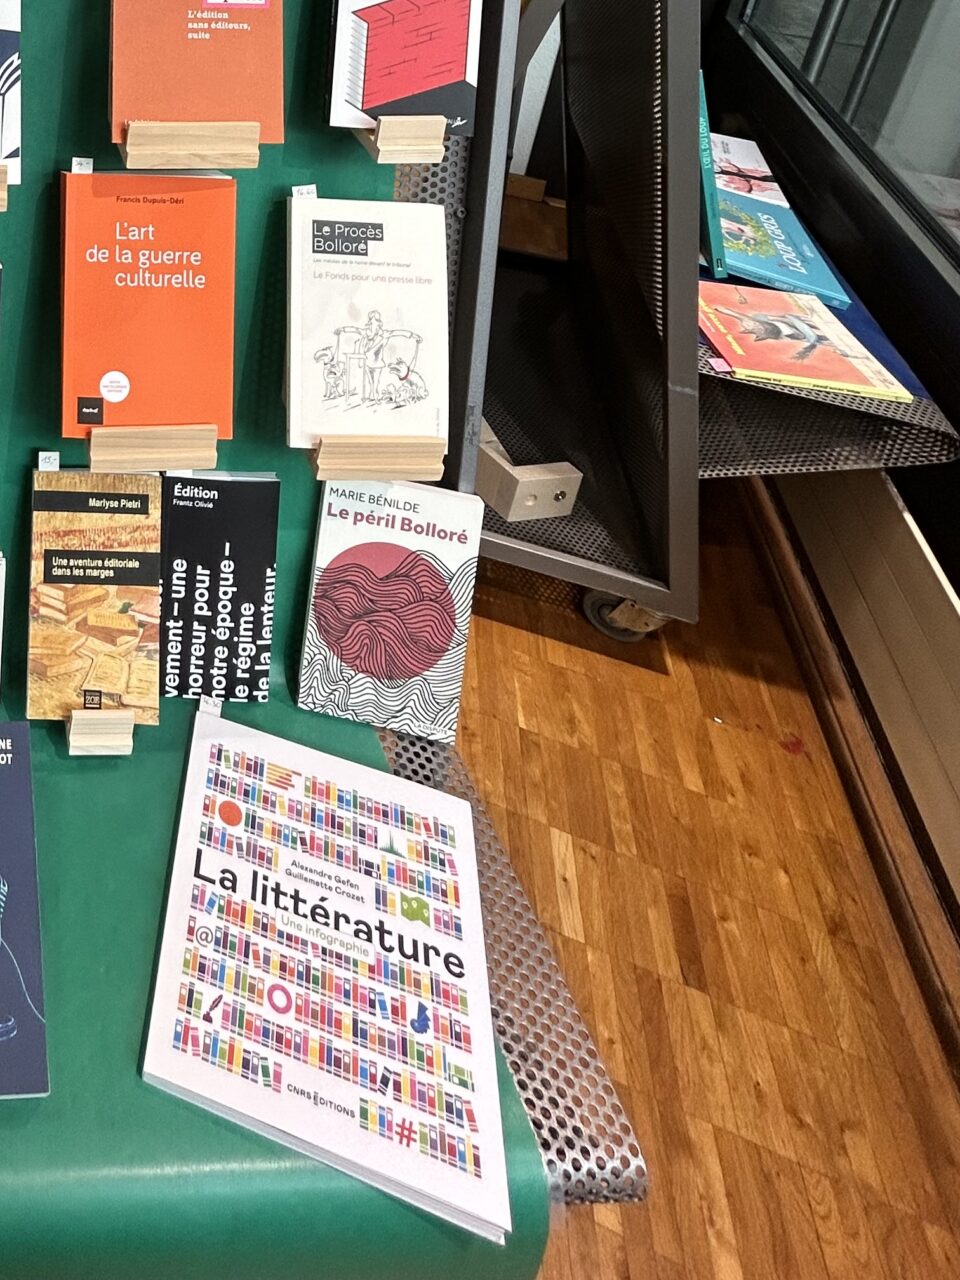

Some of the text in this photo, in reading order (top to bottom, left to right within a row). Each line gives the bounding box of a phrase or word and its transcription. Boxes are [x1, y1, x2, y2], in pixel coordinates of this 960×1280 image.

[114, 221, 155, 241] L'art
[313, 222, 383, 239] Le Procès
[85, 244, 202, 269] de la guerre
[313, 237, 368, 254] Bolloré
[114, 270, 206, 290] culturelle
[89, 498, 141, 509] Marlyse Pietri
[174, 482, 218, 500] Édition
[329, 487, 420, 513] MARIE BÉNILDE
[327, 502, 468, 545] Le péril Bolloré
[52, 557, 140, 569] Une aventure éditoriale
[52, 567, 114, 579] dans les marges
[165, 558, 188, 698] vement une
[183, 565, 212, 700] horreur pour
[211, 558, 237, 701] notre époque
[230, 602, 256, 703] le régime
[253, 651, 272, 671] la
[253, 676, 270, 702] de
[193, 849, 466, 979] La littérature
[281, 914, 370, 959] Une infographie
